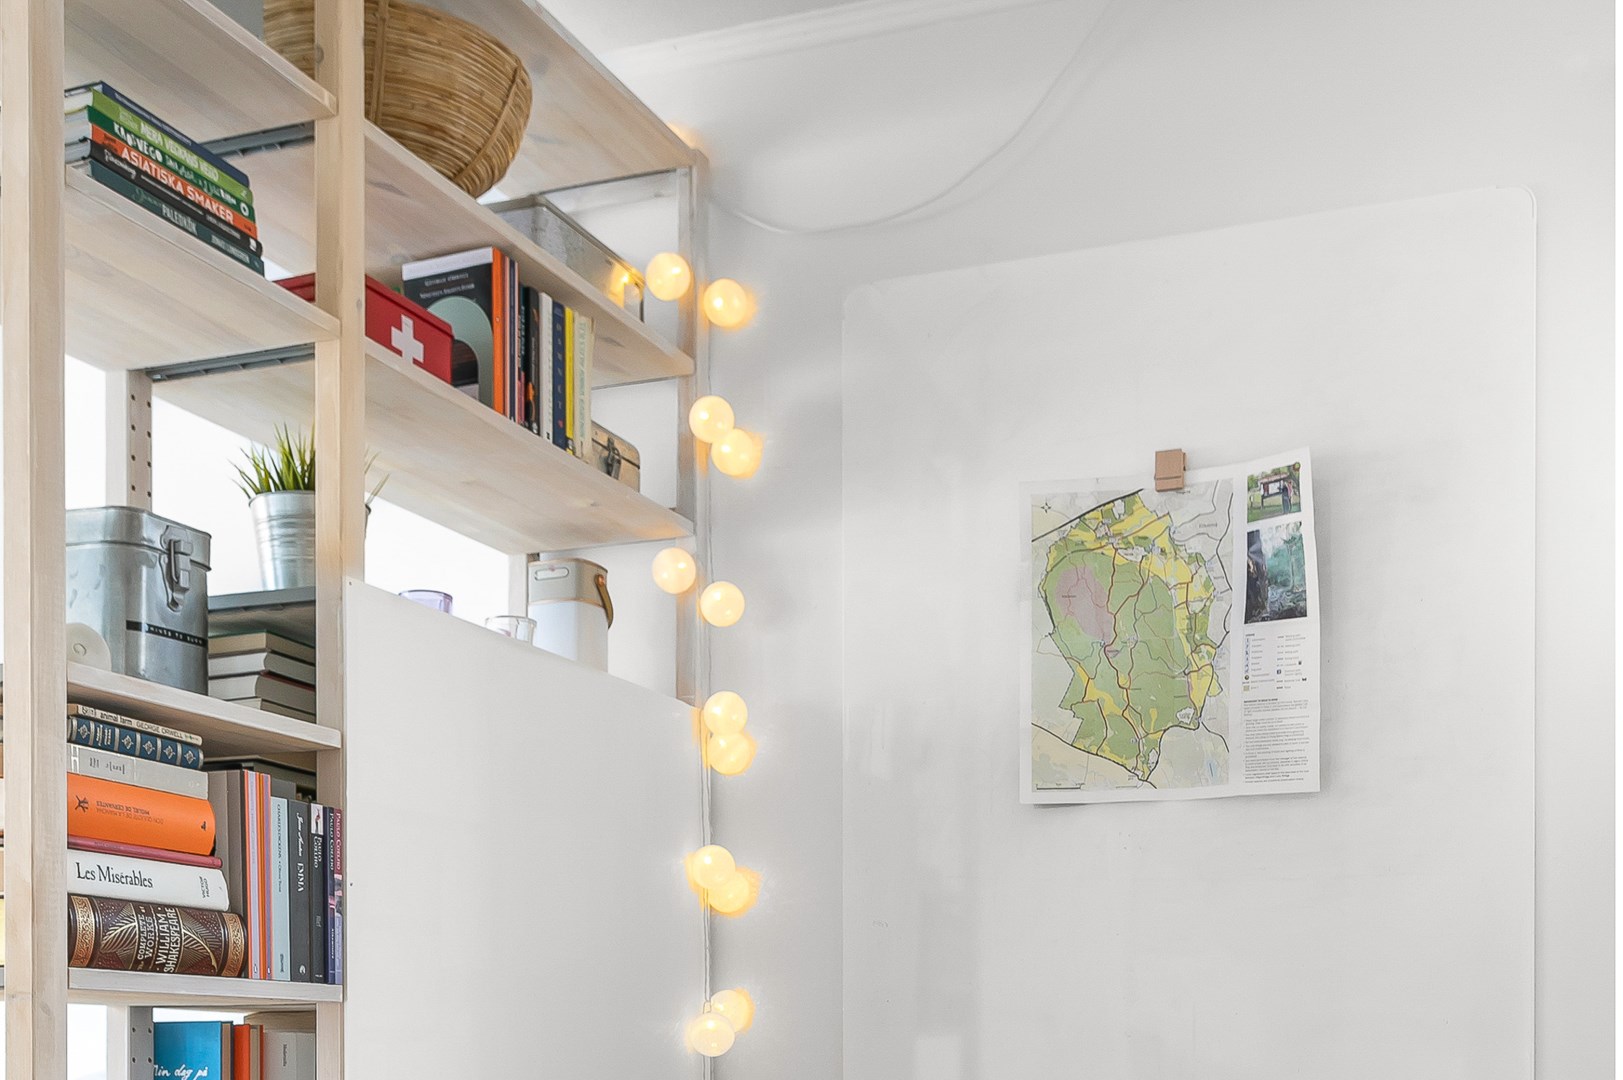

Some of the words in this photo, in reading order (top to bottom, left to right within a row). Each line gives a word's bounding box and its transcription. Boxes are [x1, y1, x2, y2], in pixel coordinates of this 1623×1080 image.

[121, 146, 184, 195] ASIATISKA
[187, 185, 234, 226] SMAKER
[100, 711, 119, 724] animal
[136, 720, 160, 733] GEORGE
[75, 862, 96, 881] Les
[96, 864, 154, 889] Misérables
[297, 862, 305, 892] EMMA
[137, 914, 147, 960] COMPLETE
[144, 916, 154, 959] WORKS
[155, 913, 169, 965] WILLIAM
[163, 907, 180, 973] SHAKESPEARE
